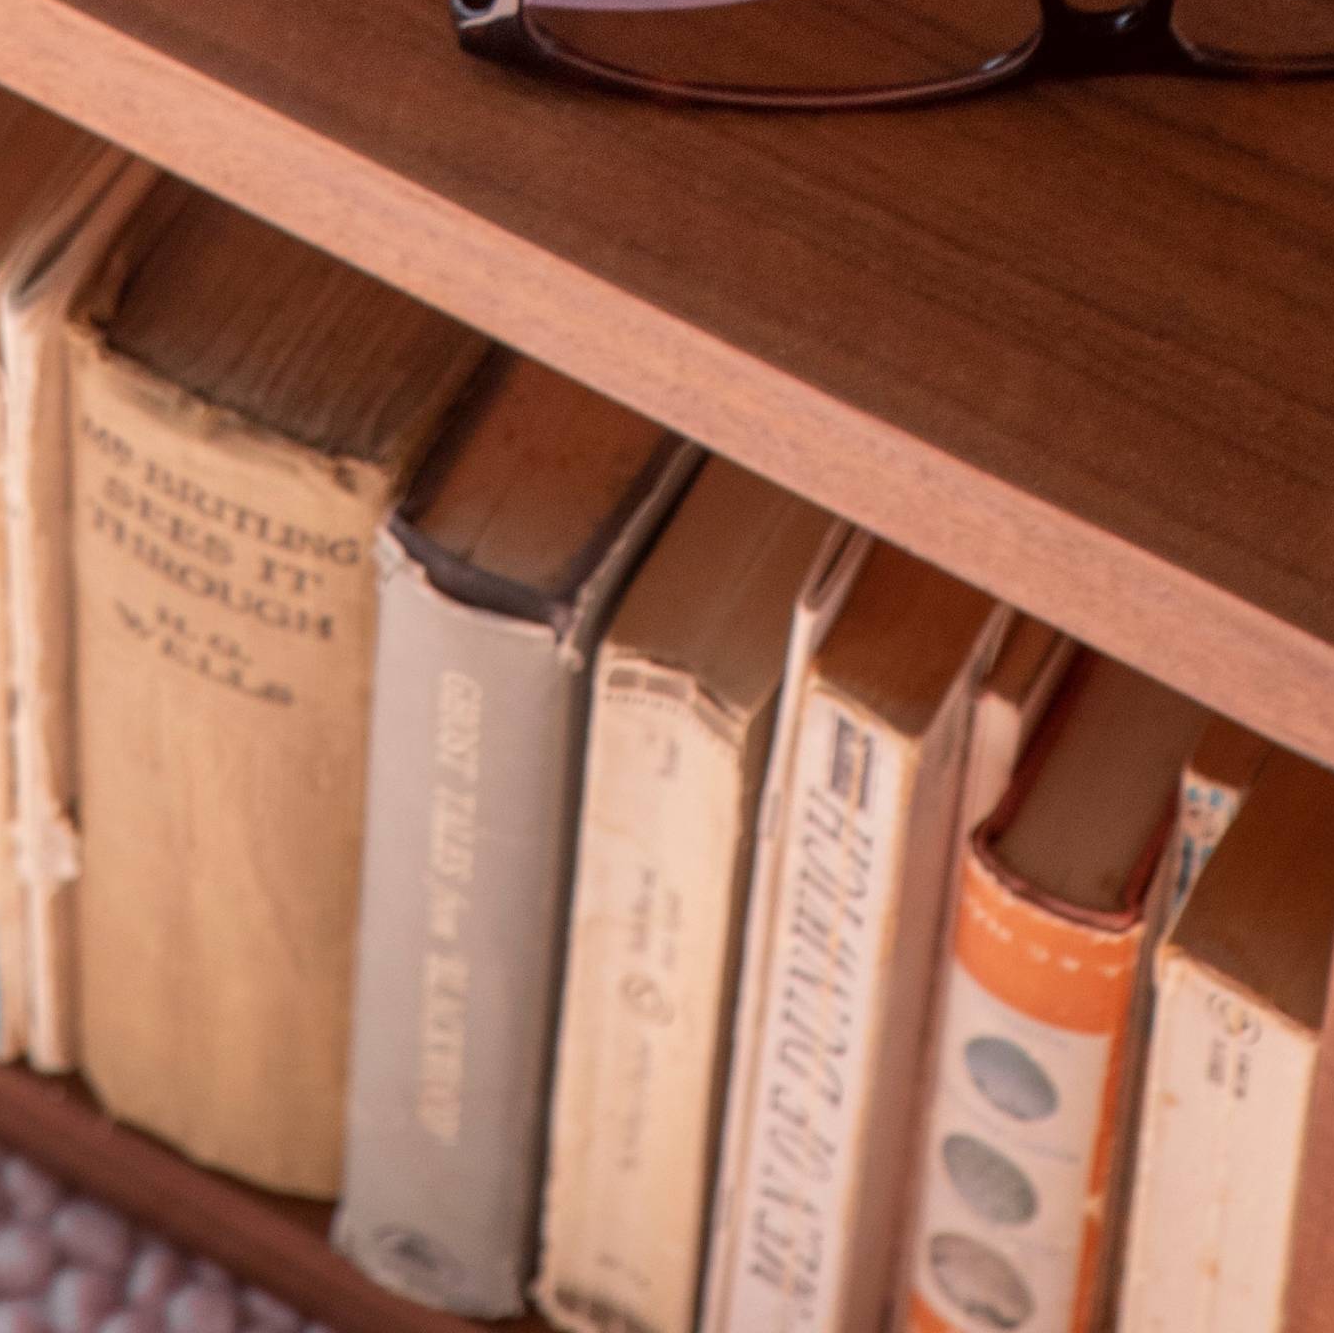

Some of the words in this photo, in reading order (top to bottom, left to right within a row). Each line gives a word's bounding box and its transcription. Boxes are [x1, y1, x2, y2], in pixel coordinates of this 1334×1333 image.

[91, 501, 334, 641] THROUGH
[104, 476, 234, 567] SEES
[261, 555, 324, 595] IT
[114, 597, 295, 706] WELLS
[436, 669, 484, 781] GHOST
[774, 787, 875, 1109] DUNWICH
[766, 1081, 837, 1185] OF
[746, 1162, 821, 1320] MEN
